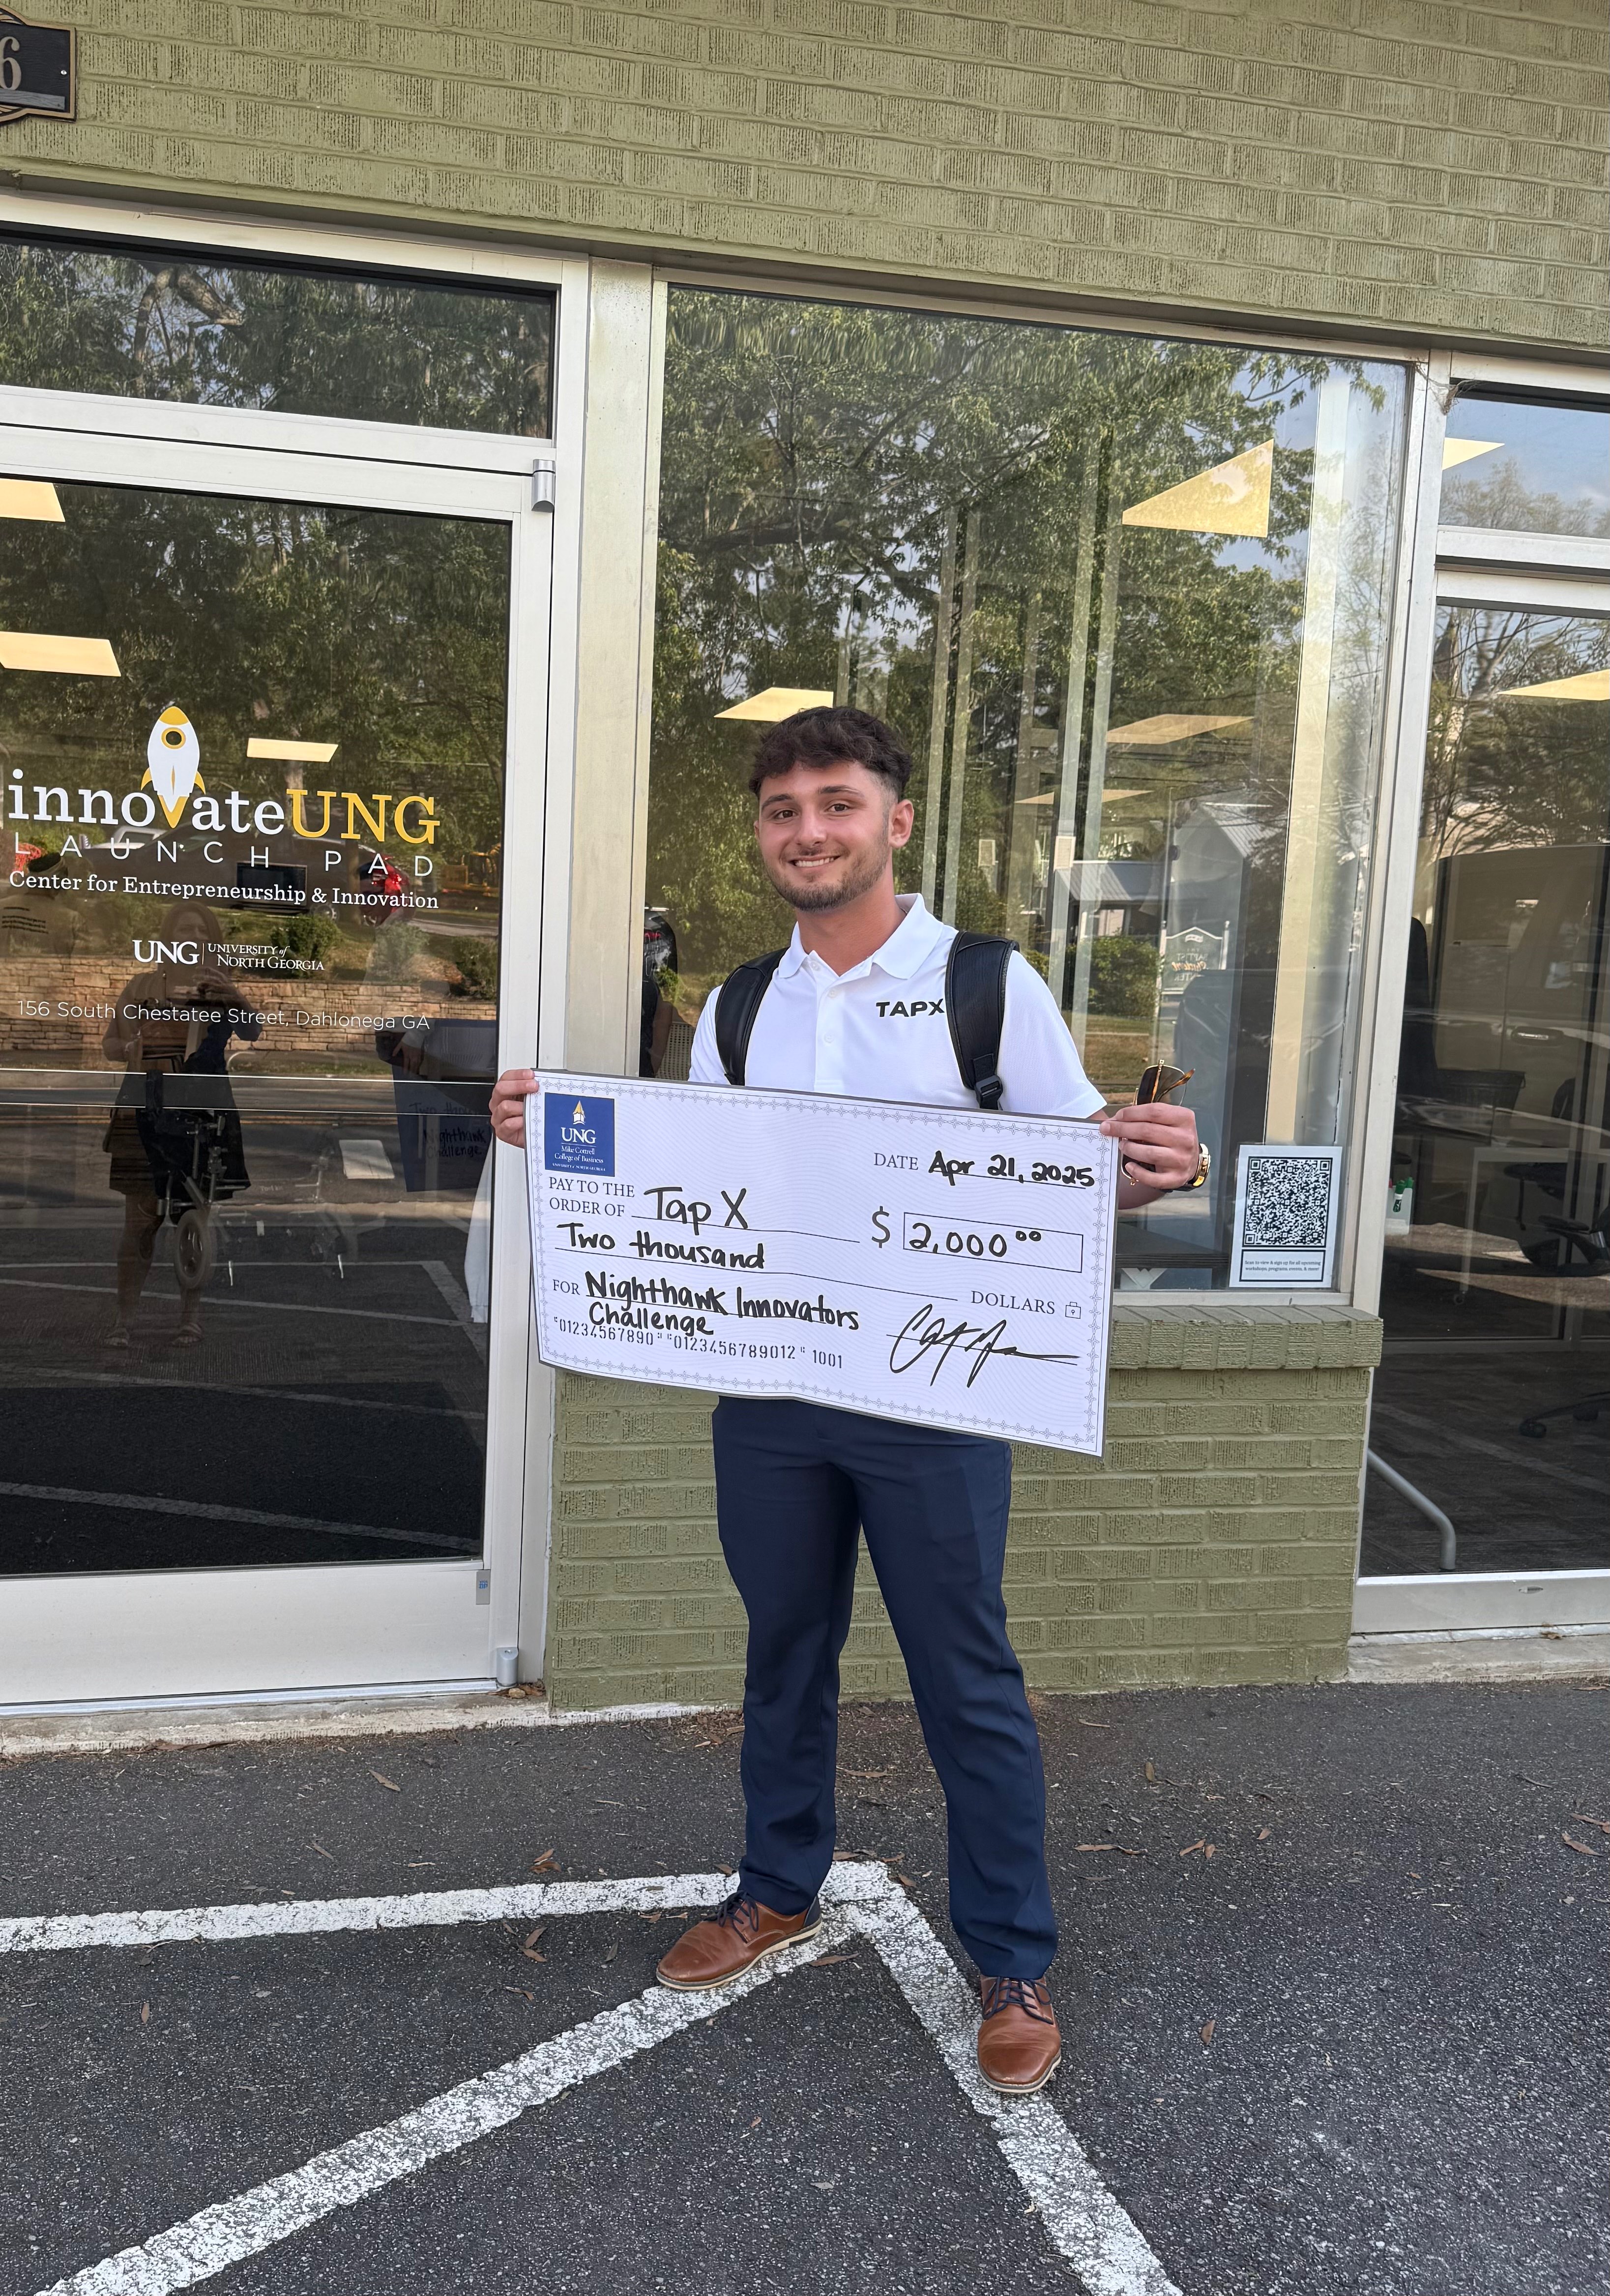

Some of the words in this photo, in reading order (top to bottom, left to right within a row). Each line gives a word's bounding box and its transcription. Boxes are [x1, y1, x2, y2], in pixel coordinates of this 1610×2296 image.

[15, 832, 269, 868] LAUNCH
[324, 850, 433, 877] PAD
[9, 871, 82, 890] Center
[87, 874, 117, 892] for
[123, 876, 306, 905] Entrepreneurship
[311, 888, 327, 903] &
[332, 888, 439, 909] Innovation
[132, 940, 200, 964] UNG
[207, 943, 278, 955] UNIVERSITY
[279, 946, 290, 958] of
[217, 954, 265, 968] NORTH
[267, 956, 325, 971] GEORGIA
[18, 1000, 50, 1016] 156
[58, 1001, 116, 1019] South
[123, 1004, 221, 1023] Chestatee
[228, 1008, 290, 1027] Street,
[296, 1011, 395, 1031] Dahlonega
[402, 1015, 430, 1029] GA
[876, 998, 945, 1017] TAPX
[561, 1127, 596, 1144] UNG
[555, 1153, 573, 1163] College
[575, 1146, 595, 1155] Cottrell
[874, 1153, 918, 1170] DATE
[929, 1151, 975, 1186] Apr
[987, 1155, 1024, 1183] 21,
[1032, 1163, 1095, 1187] 2025
[549, 1177, 574, 1193] PAY
[577, 1180, 598, 1194] TO
[603, 1182, 635, 1197] THE
[550, 1199, 601, 1215] ORDER
[604, 1203, 624, 1217] OF
[644, 1186, 712, 1236] Tap
[721, 1188, 748, 1229] X
[871, 1206, 890, 1248] $
[556, 1223, 615, 1250] Two
[629, 1230, 764, 1269] thousand
[908, 1223, 1007, 1257] 2,000
[553, 1280, 581, 1295] FOR
[585, 1271, 729, 1316] Nighthawk
[737, 1286, 859, 1331] Innovators
[971, 1291, 1055, 1315] DOLLARS
[589, 1301, 714, 1337] Challenge
[812, 1349, 843, 1369] 1001
